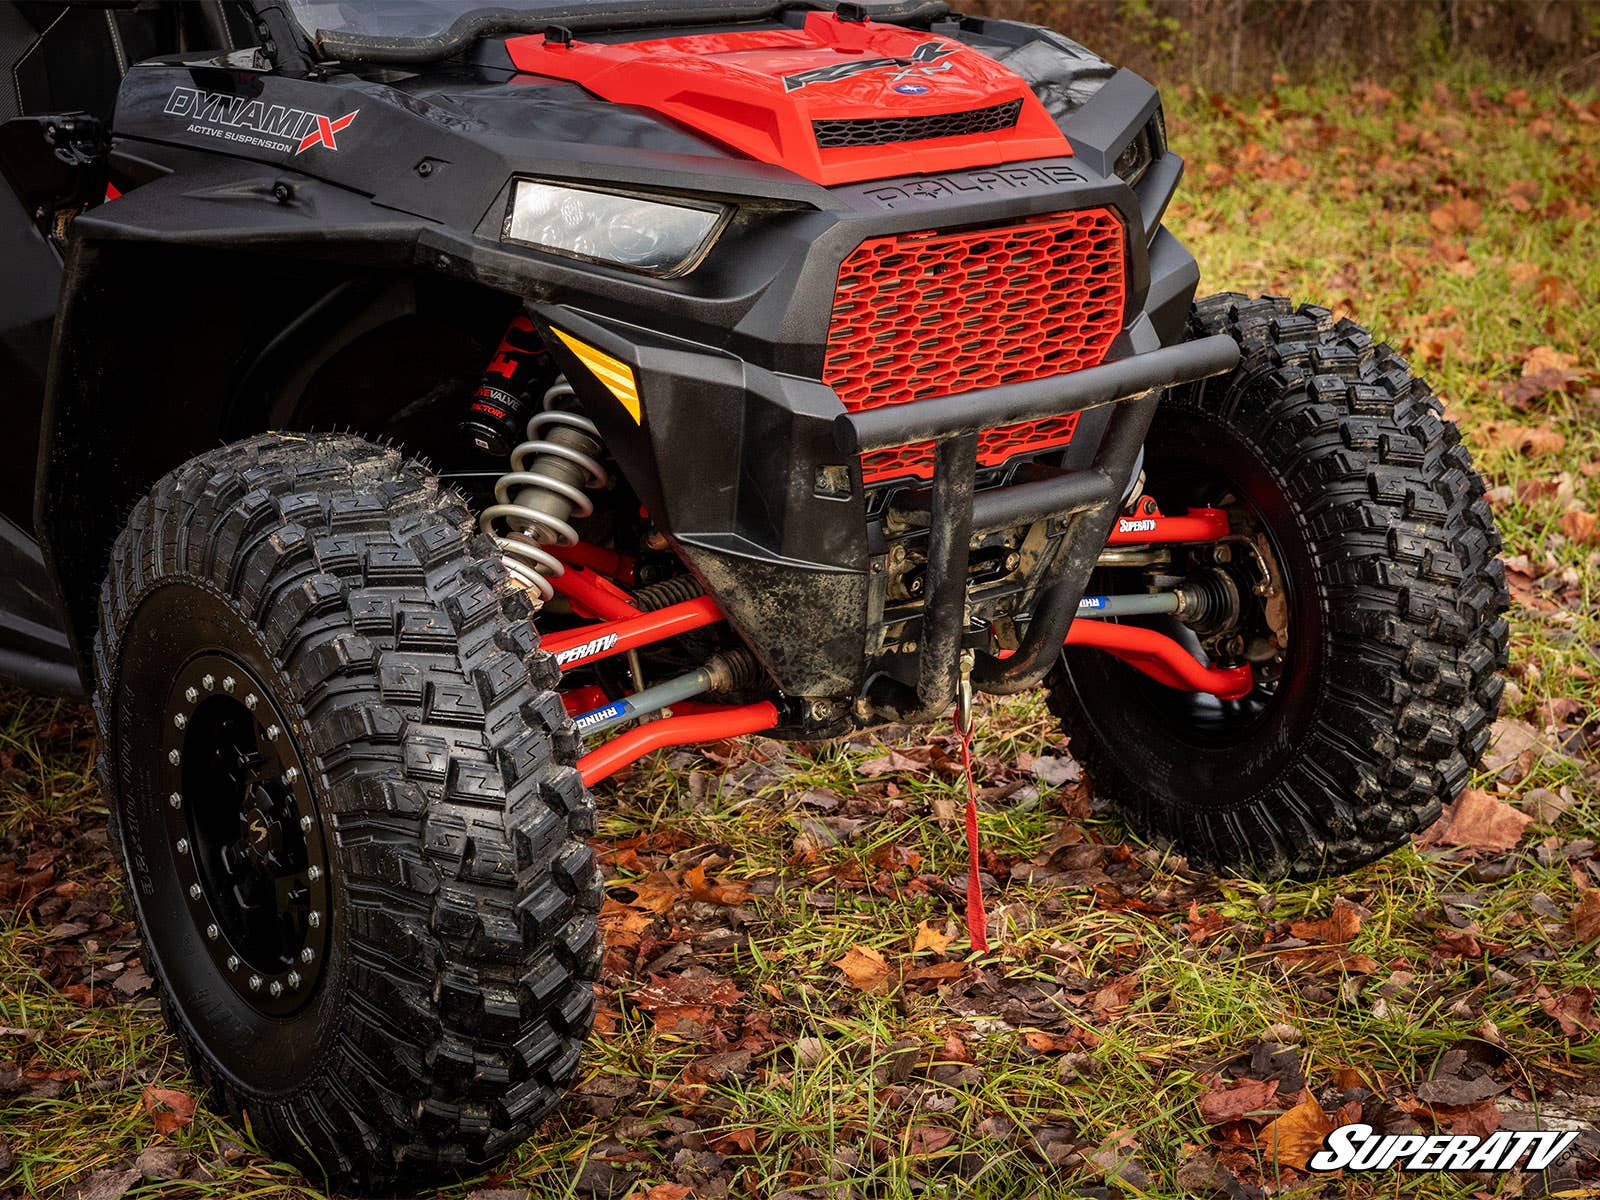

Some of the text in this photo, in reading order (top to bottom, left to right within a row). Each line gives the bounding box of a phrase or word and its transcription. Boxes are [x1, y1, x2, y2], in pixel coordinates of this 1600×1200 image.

[163, 86, 360, 156] DYNAMIX
[187, 124, 292, 153] ACTIVE SUSPENSION
[863, 166, 1088, 208] POLARIS
[1119, 519, 1156, 533] SUPERATV
